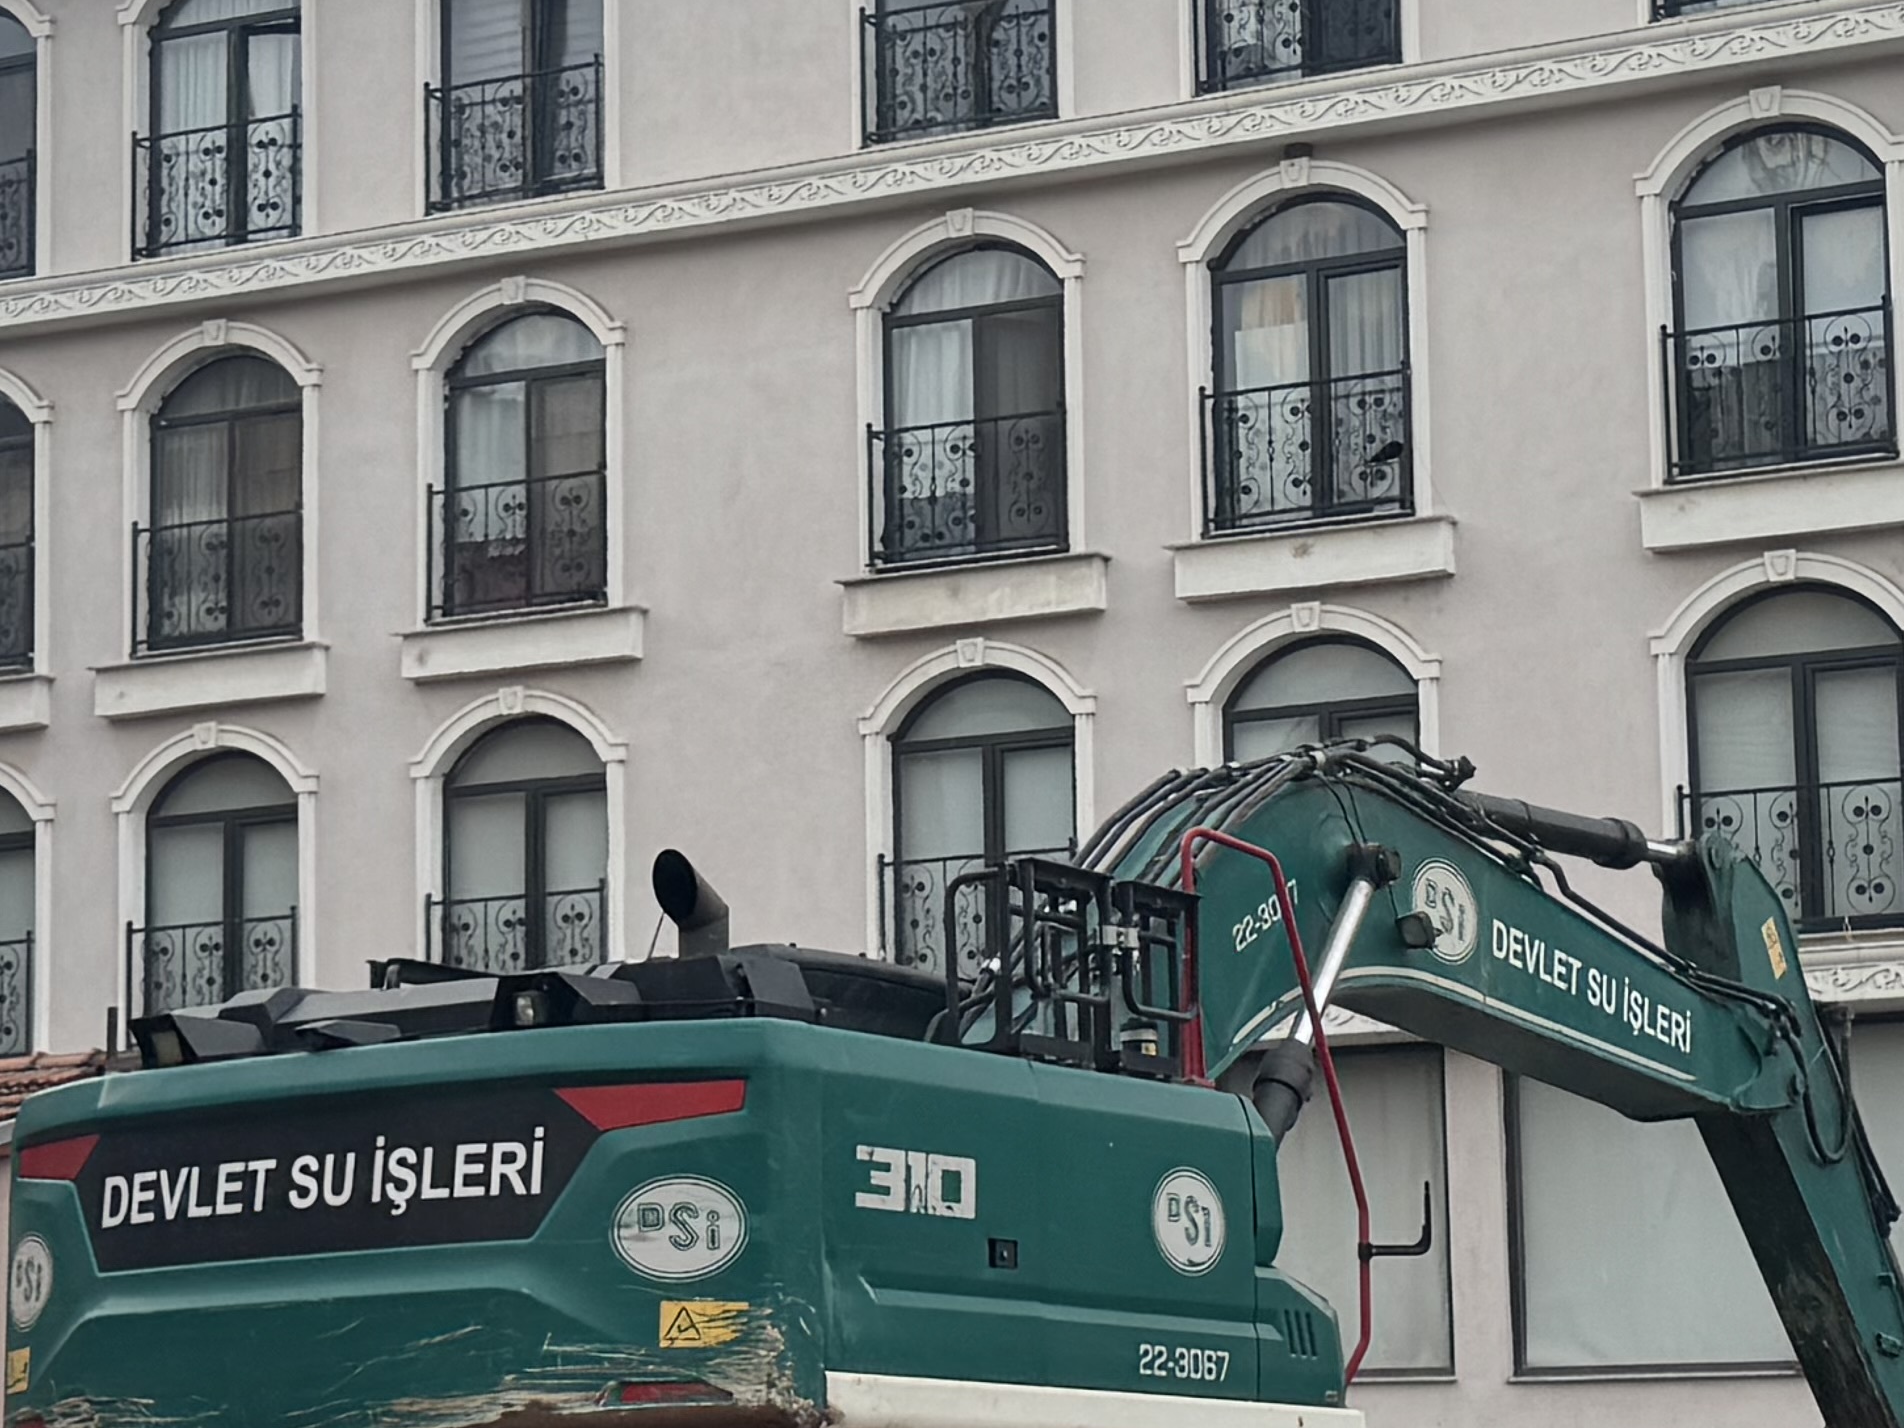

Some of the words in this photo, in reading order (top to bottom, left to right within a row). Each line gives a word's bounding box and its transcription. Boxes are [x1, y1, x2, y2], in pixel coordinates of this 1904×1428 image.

[1232, 879, 1298, 952] 22-307
[1492, 918, 1582, 996] DEVLET
[1587, 968, 1616, 1015] SU
[1623, 977, 1691, 1054] İŞLERİ
[101, 1158, 277, 1229] DEVLET
[288, 1152, 356, 1209] SU
[371, 1126, 545, 1216] İŞLERİ
[855, 1144, 977, 1220] 310
[1139, 1343, 1230, 1382] 22-3067
